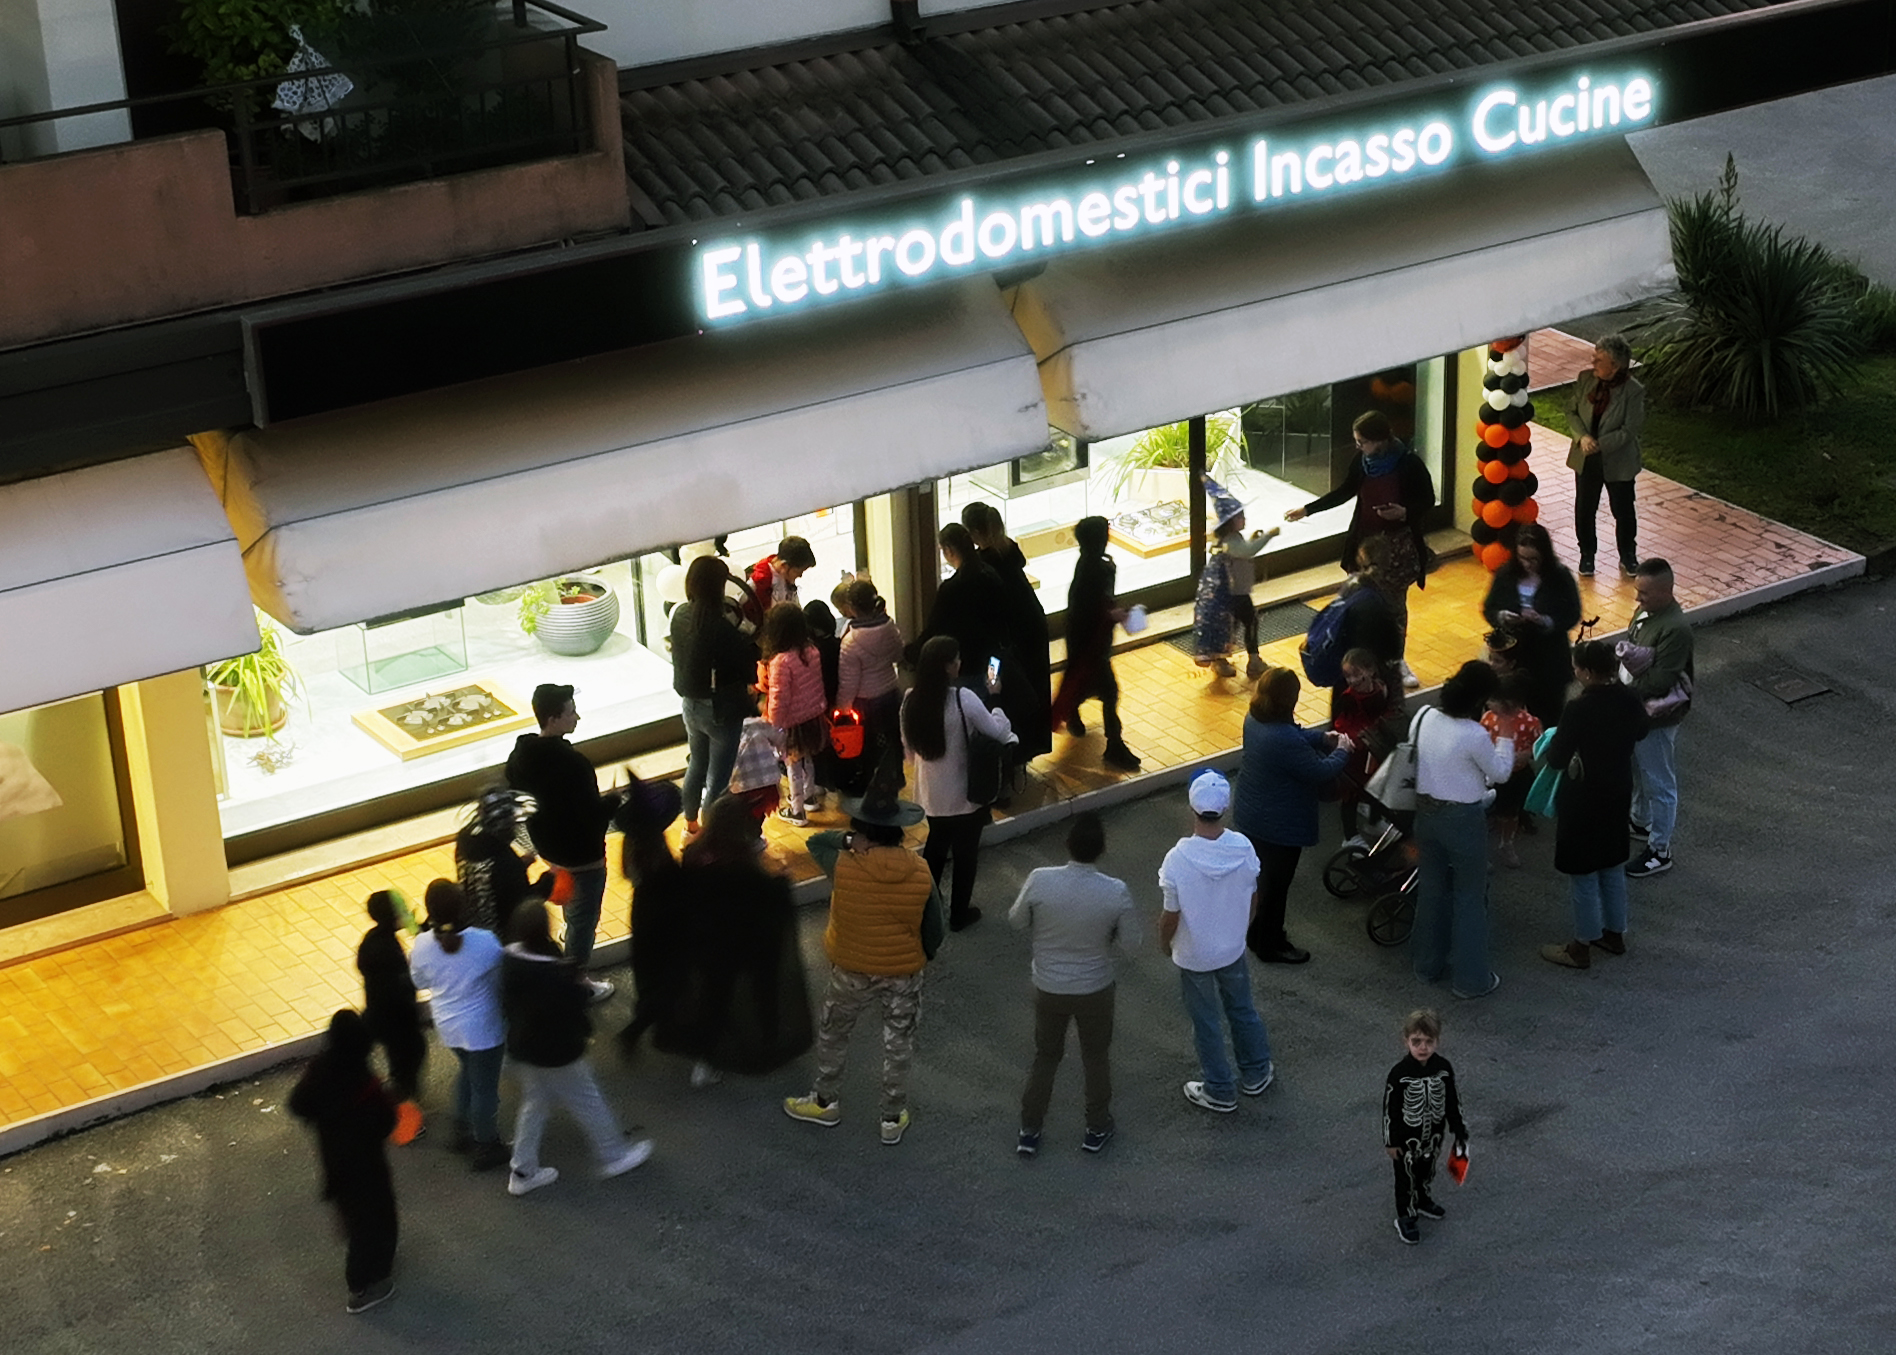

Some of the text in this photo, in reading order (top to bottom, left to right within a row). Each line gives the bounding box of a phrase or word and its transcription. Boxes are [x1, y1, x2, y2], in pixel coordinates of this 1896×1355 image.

[700, 75, 1653, 321] Elettrodomestici Incasso Cucine
